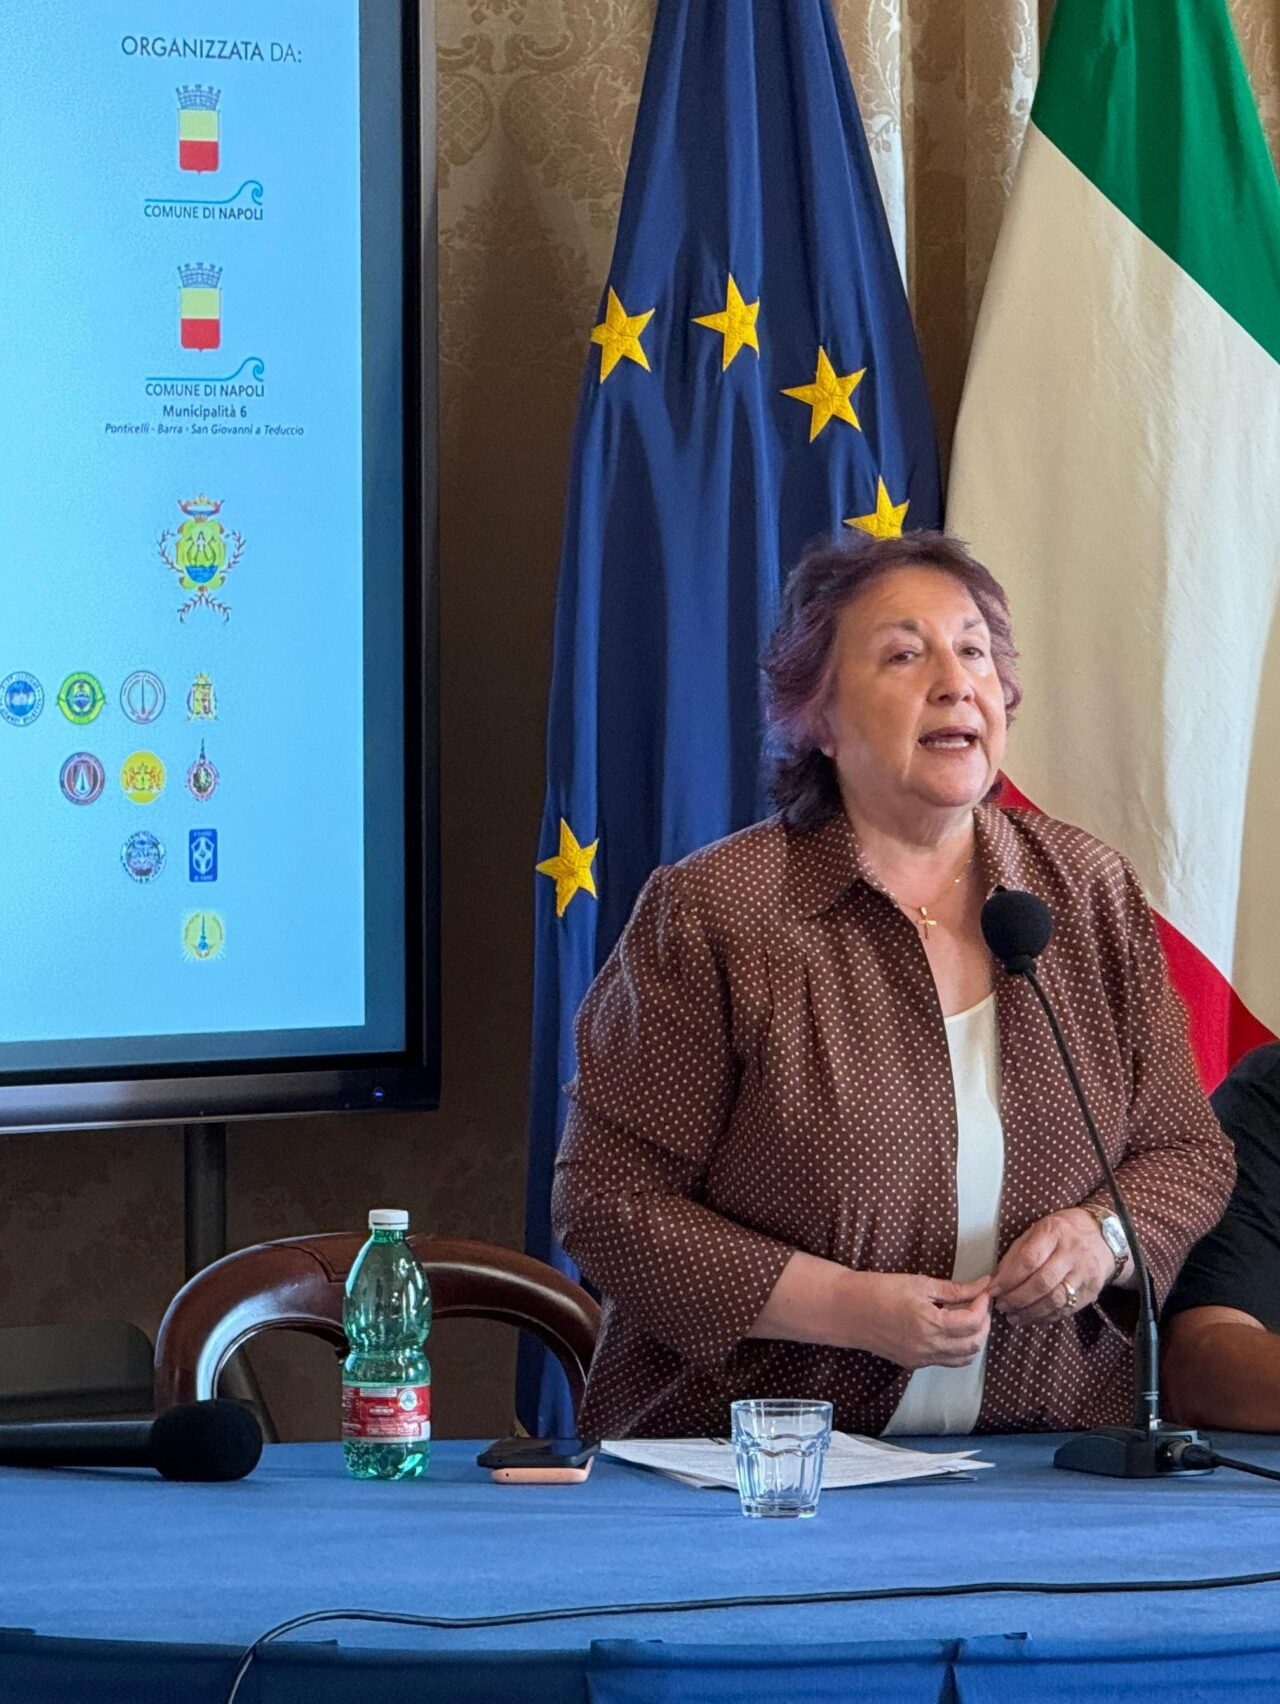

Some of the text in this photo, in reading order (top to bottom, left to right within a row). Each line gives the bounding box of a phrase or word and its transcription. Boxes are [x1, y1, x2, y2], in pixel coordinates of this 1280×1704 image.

[121, 35, 302, 63] ORGANIZZATA DA:
[144, 204, 263, 220] COMUNE DI NAPOLI
[145, 383, 265, 397] COMUNE DI NAPOLI
[163, 404, 247, 420] Municipalità 6
[105, 423, 149, 434] Ponticelli
[158, 423, 183, 434] Barra
[191, 424, 208, 435] San
[211, 424, 253, 435] Giovanni
[255, 427, 261, 435] a
[264, 424, 304, 436] Teduccio
